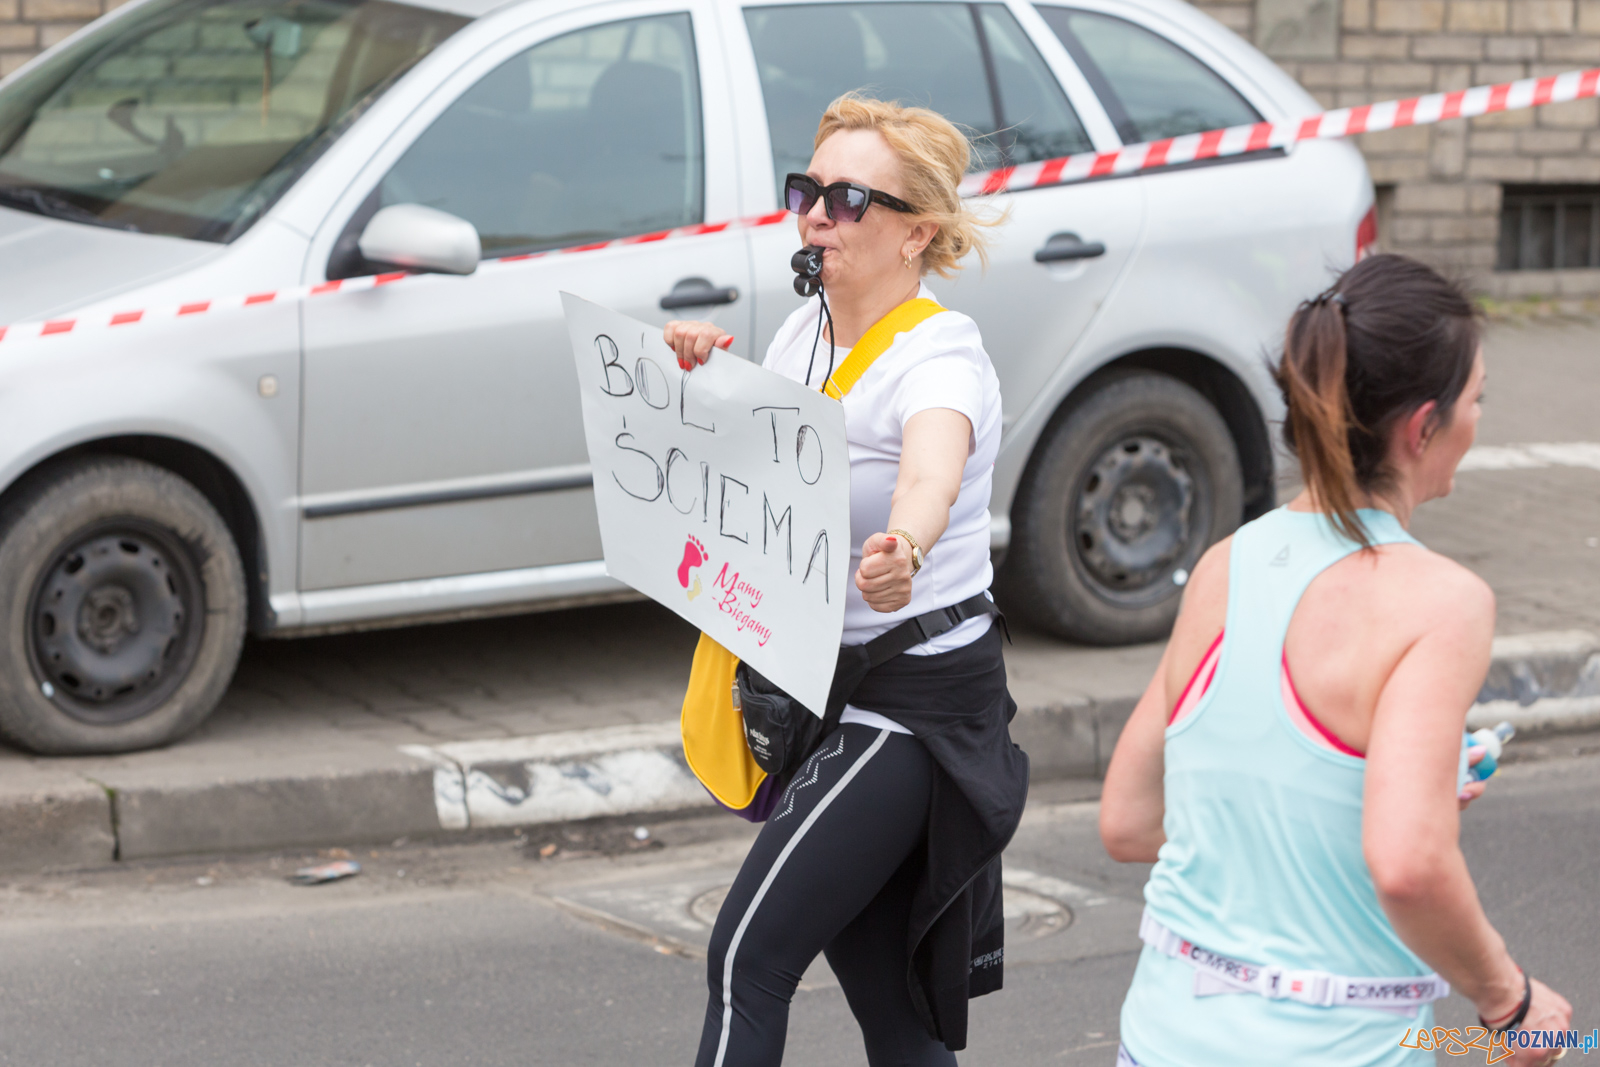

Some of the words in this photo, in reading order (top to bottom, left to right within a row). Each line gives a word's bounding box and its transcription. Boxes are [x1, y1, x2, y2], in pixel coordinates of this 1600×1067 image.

[752, 406, 823, 486] TO
[612, 415, 830, 605] ŚCIEMA
[713, 562, 764, 609] Mamy
